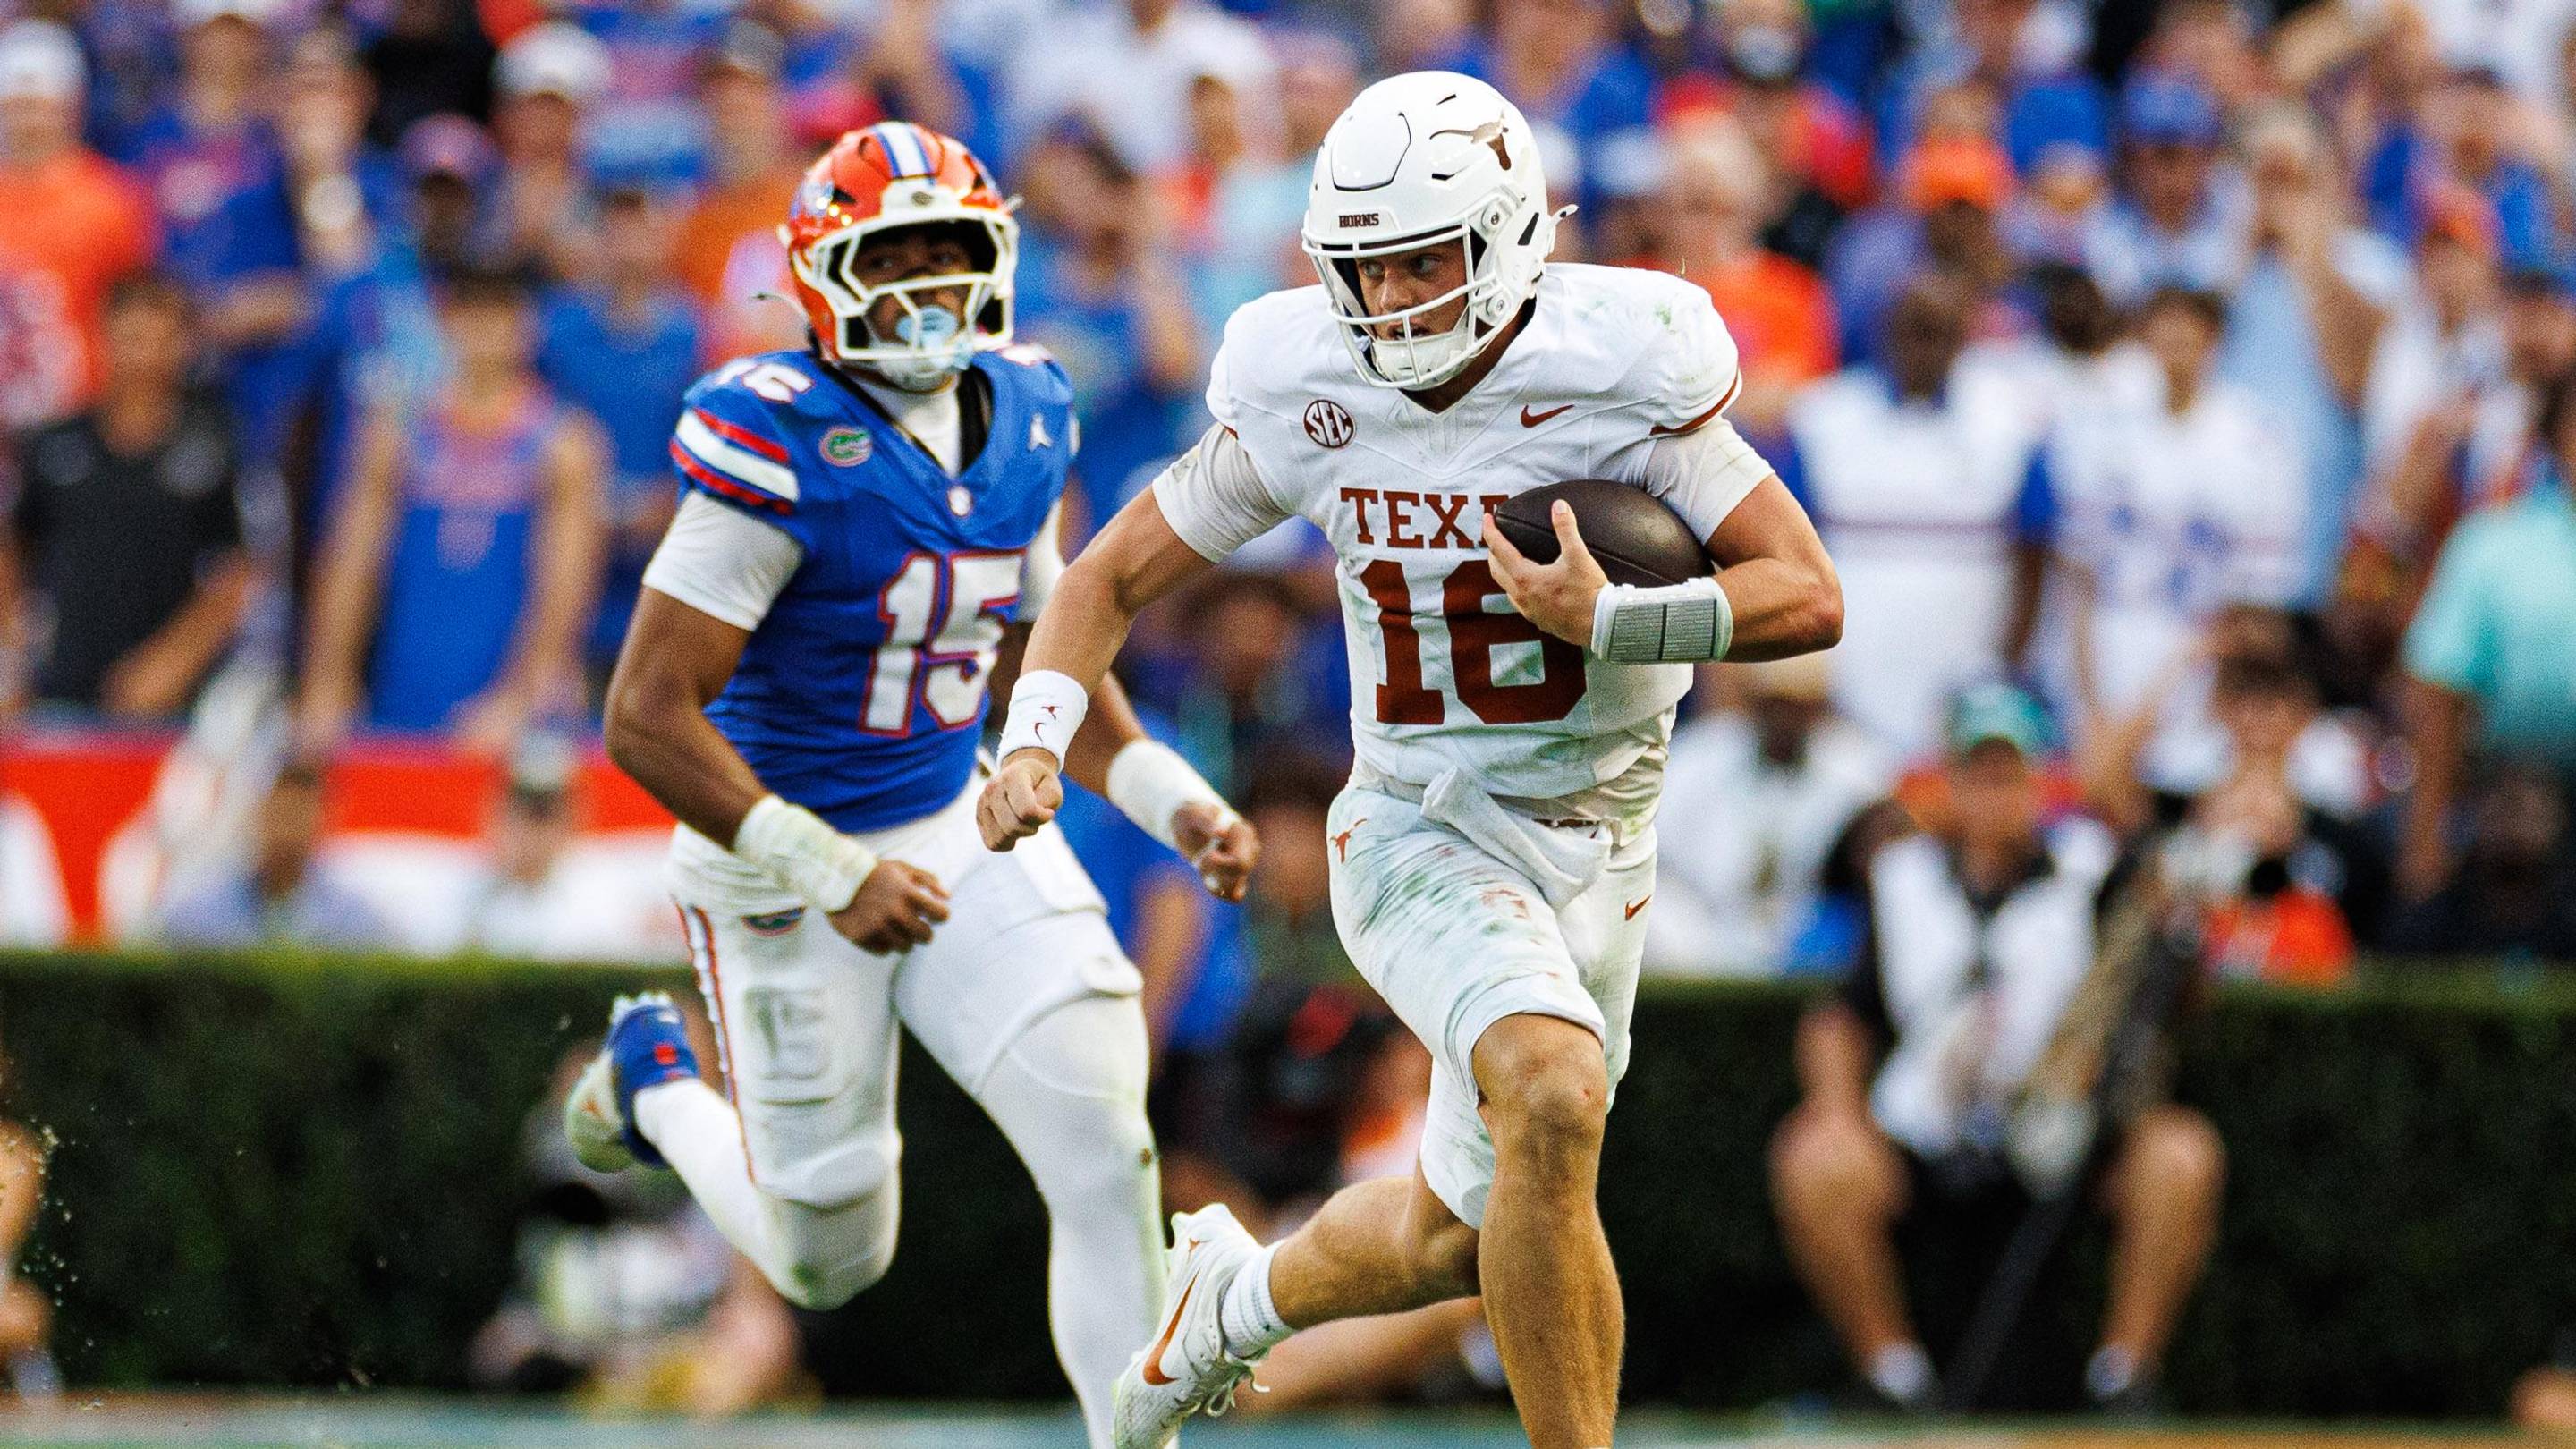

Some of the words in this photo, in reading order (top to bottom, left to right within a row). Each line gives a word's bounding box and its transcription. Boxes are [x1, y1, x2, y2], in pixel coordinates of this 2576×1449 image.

[1338, 212, 1380, 228] HORNS
[1305, 401, 1353, 446] SEC
[859, 548, 1026, 739] 15
[1360, 559, 1587, 725] 16
